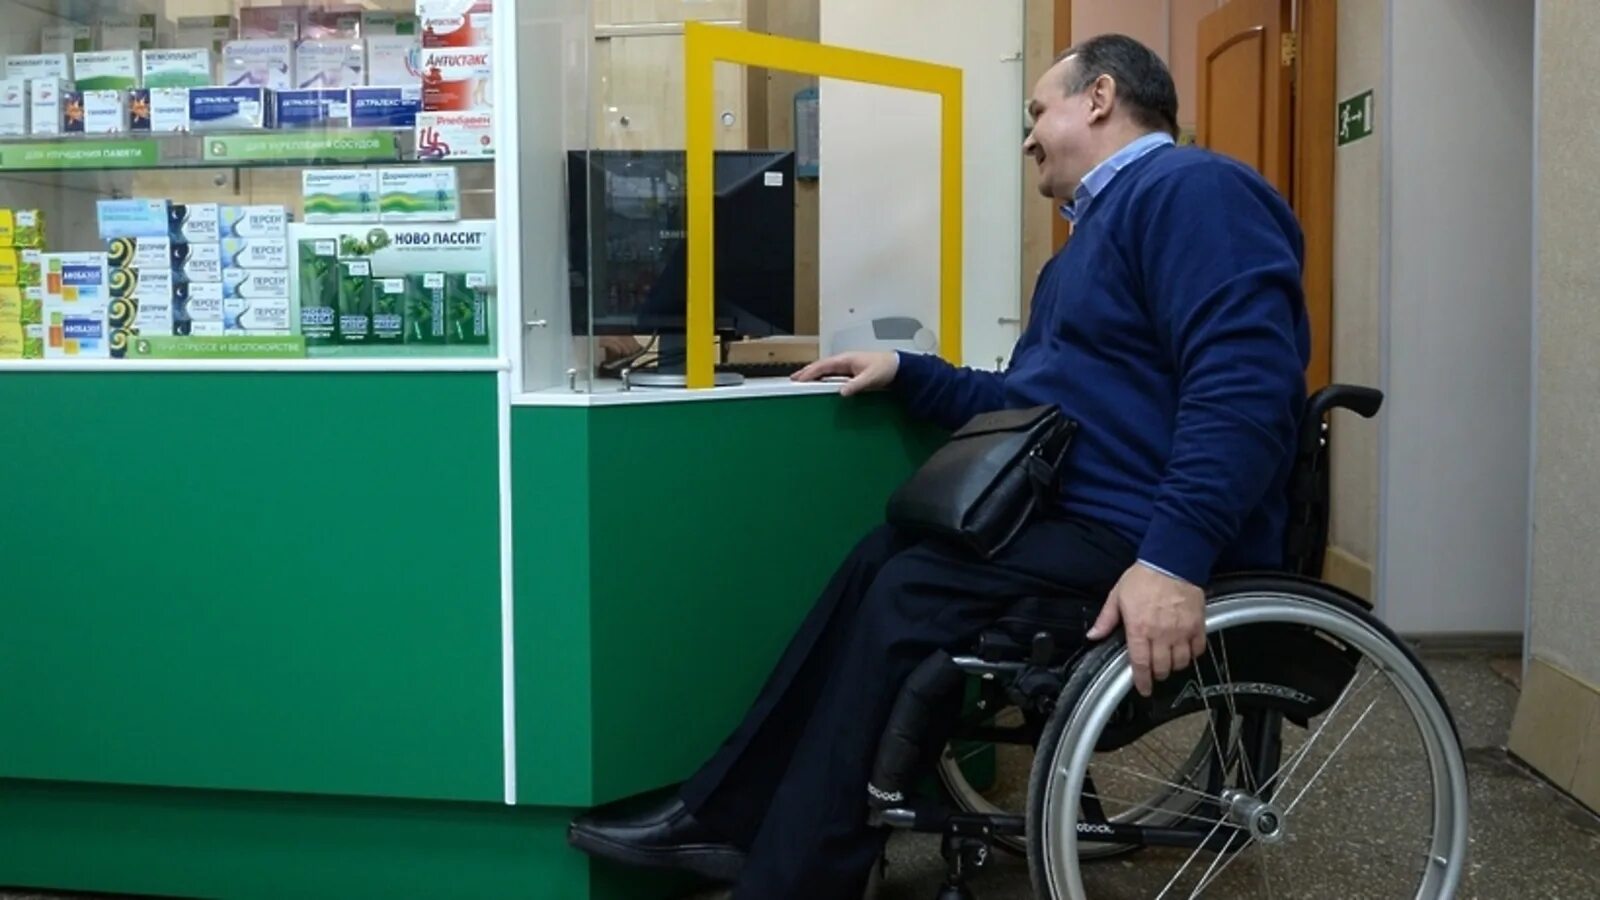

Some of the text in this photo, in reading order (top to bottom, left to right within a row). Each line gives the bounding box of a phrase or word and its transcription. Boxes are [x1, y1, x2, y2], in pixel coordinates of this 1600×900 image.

[425, 54, 488, 67] Антистакс
[333, 139, 380, 149] СОСУДОВ
[103, 148, 142, 158] ПАМЯТИ
[250, 215, 281, 223] ПЕРСЕН
[395, 232, 482, 245] НОВО ПАССИТ
[252, 246, 283, 255] ПЕРСЕН
[253, 276, 285, 285] ПЕРСЕН
[254, 307, 286, 316] ПЕРСЕН
[177, 343, 218, 352] СТРЕССЕ
[229, 343, 299, 352] БЕСПОКОЙСТВЕ
